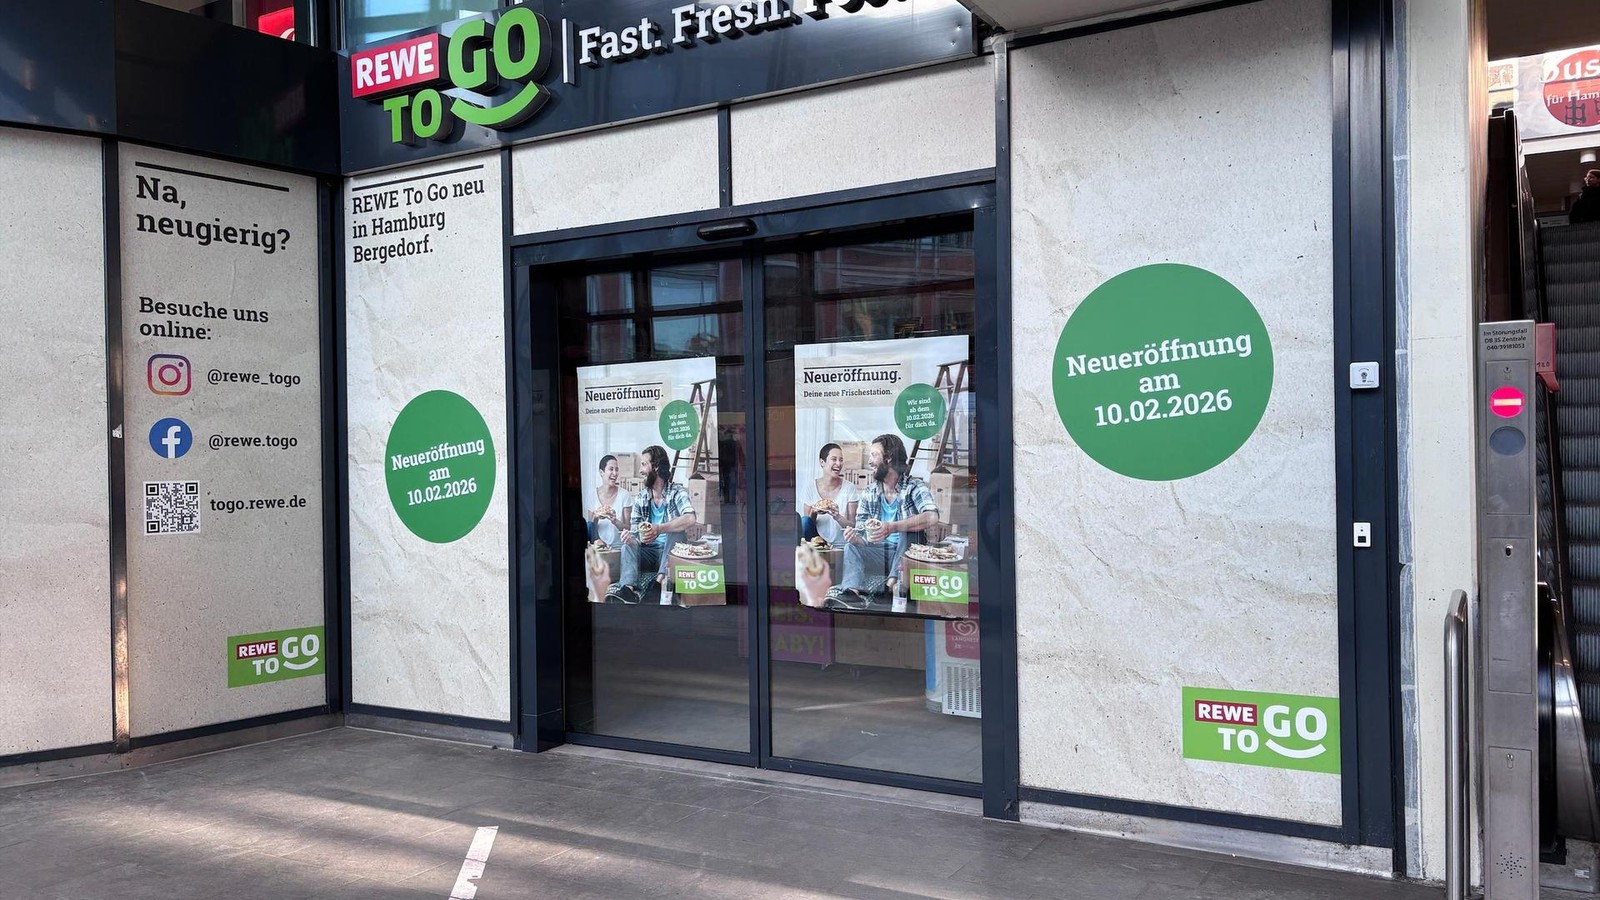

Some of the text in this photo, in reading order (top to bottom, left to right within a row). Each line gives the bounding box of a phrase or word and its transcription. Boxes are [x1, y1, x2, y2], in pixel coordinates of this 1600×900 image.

[579, 17, 662, 65] Fast.
[356, 41, 435, 89] REWE
[383, 7, 541, 143] TO GO
[1547, 93, 1564, 107] für
[136, 174, 187, 210] Na,
[352, 180, 485, 215] REWE To Go neu
[136, 213, 291, 255] neugierig?
[352, 211, 445, 239] in Hamburg
[353, 234, 433, 264] Bergedorf.
[139, 297, 269, 323] Besuche uns
[139, 321, 212, 340] online:
[1066, 333, 1252, 377] Neueröffnung
[207, 369, 301, 388] @rewe_togo
[803, 368, 902, 384] Neueröffnung.
[1139, 372, 1181, 393] am
[585, 387, 664, 402] Neueröffnung.
[803, 390, 823, 398] Deine
[841, 388, 893, 397] Frischestation.
[585, 407, 600, 415] Deine
[615, 404, 657, 413] Frischestation.
[906, 413, 935, 421] 10.02.2026
[1094, 389, 1233, 427] 10.02.2026
[208, 434, 298, 450] @rewe.togo
[390, 438, 485, 471] Neueröffnung
[428, 466, 450, 482] am
[407, 477, 477, 506] 10.02.2026
[210, 495, 307, 513] togo.rewe.de
[684, 569, 719, 590] TO GO
[914, 575, 936, 584] REWE
[922, 575, 963, 597] TO GO
[238, 641, 277, 658] REWE
[252, 634, 320, 676] TO GO
[1198, 703, 1255, 723] REWE
[1217, 704, 1328, 754] TO GO
